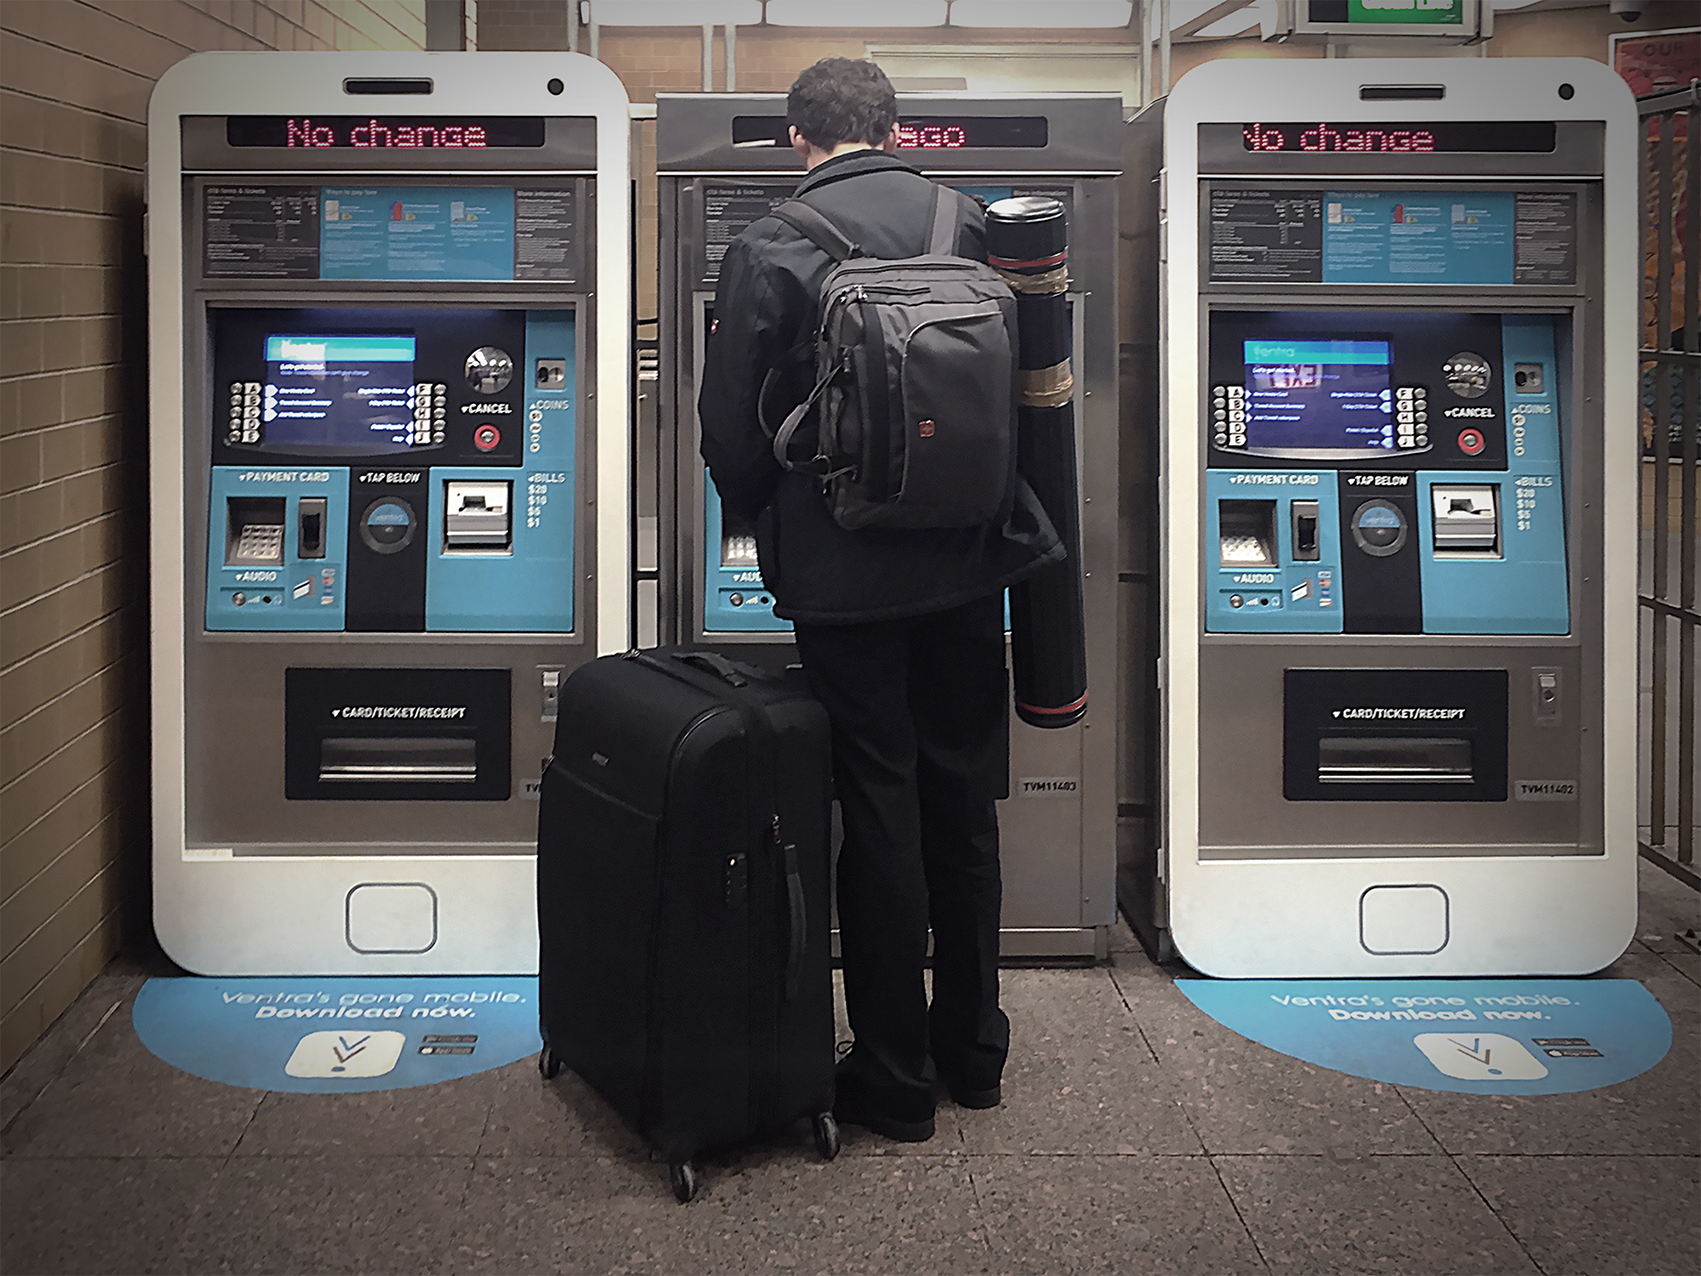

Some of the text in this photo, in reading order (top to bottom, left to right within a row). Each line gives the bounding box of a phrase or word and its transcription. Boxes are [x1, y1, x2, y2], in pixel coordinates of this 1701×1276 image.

[1643, 40, 1684, 57] OUR
[287, 119, 488, 149] No change
[1299, 123, 1435, 152] change
[469, 404, 512, 414] CANCEL
[536, 400, 569, 410] COINS
[1518, 404, 1551, 414] COINS
[1451, 407, 1495, 418] CANCEL
[246, 471, 329, 482] PAYMENT CARD
[366, 472, 420, 483] TAP BELOW
[535, 473, 565, 483] BILLS
[1237, 475, 1319, 485] PAYMENT CARD
[1354, 476, 1408, 486] TAP BELOW
[1521, 477, 1553, 487] BILLS
[528, 484, 548, 494] $20
[1516, 488, 1535, 498] $20
[528, 495, 548, 505] $10
[527, 506, 541, 517] $5
[527, 517, 540, 528] $1
[1517, 520, 1531, 531] $1
[241, 571, 277, 582] AUDIO
[1241, 574, 1274, 585] AUDIO
[342, 707, 466, 719] CARD/TICKET/RECEIPT
[1342, 708, 1465, 719] CARD/TICKET/RECEIPT
[1023, 782, 1077, 791] TVM11403
[1521, 784, 1574, 794] TVM11402
[222, 991, 527, 1007] Ventra's gone mobile.
[1270, 993, 1582, 1010] Ventra's gone mobile.
[255, 1005, 477, 1019] Download now.
[1329, 1008, 1552, 1021] Download now.
